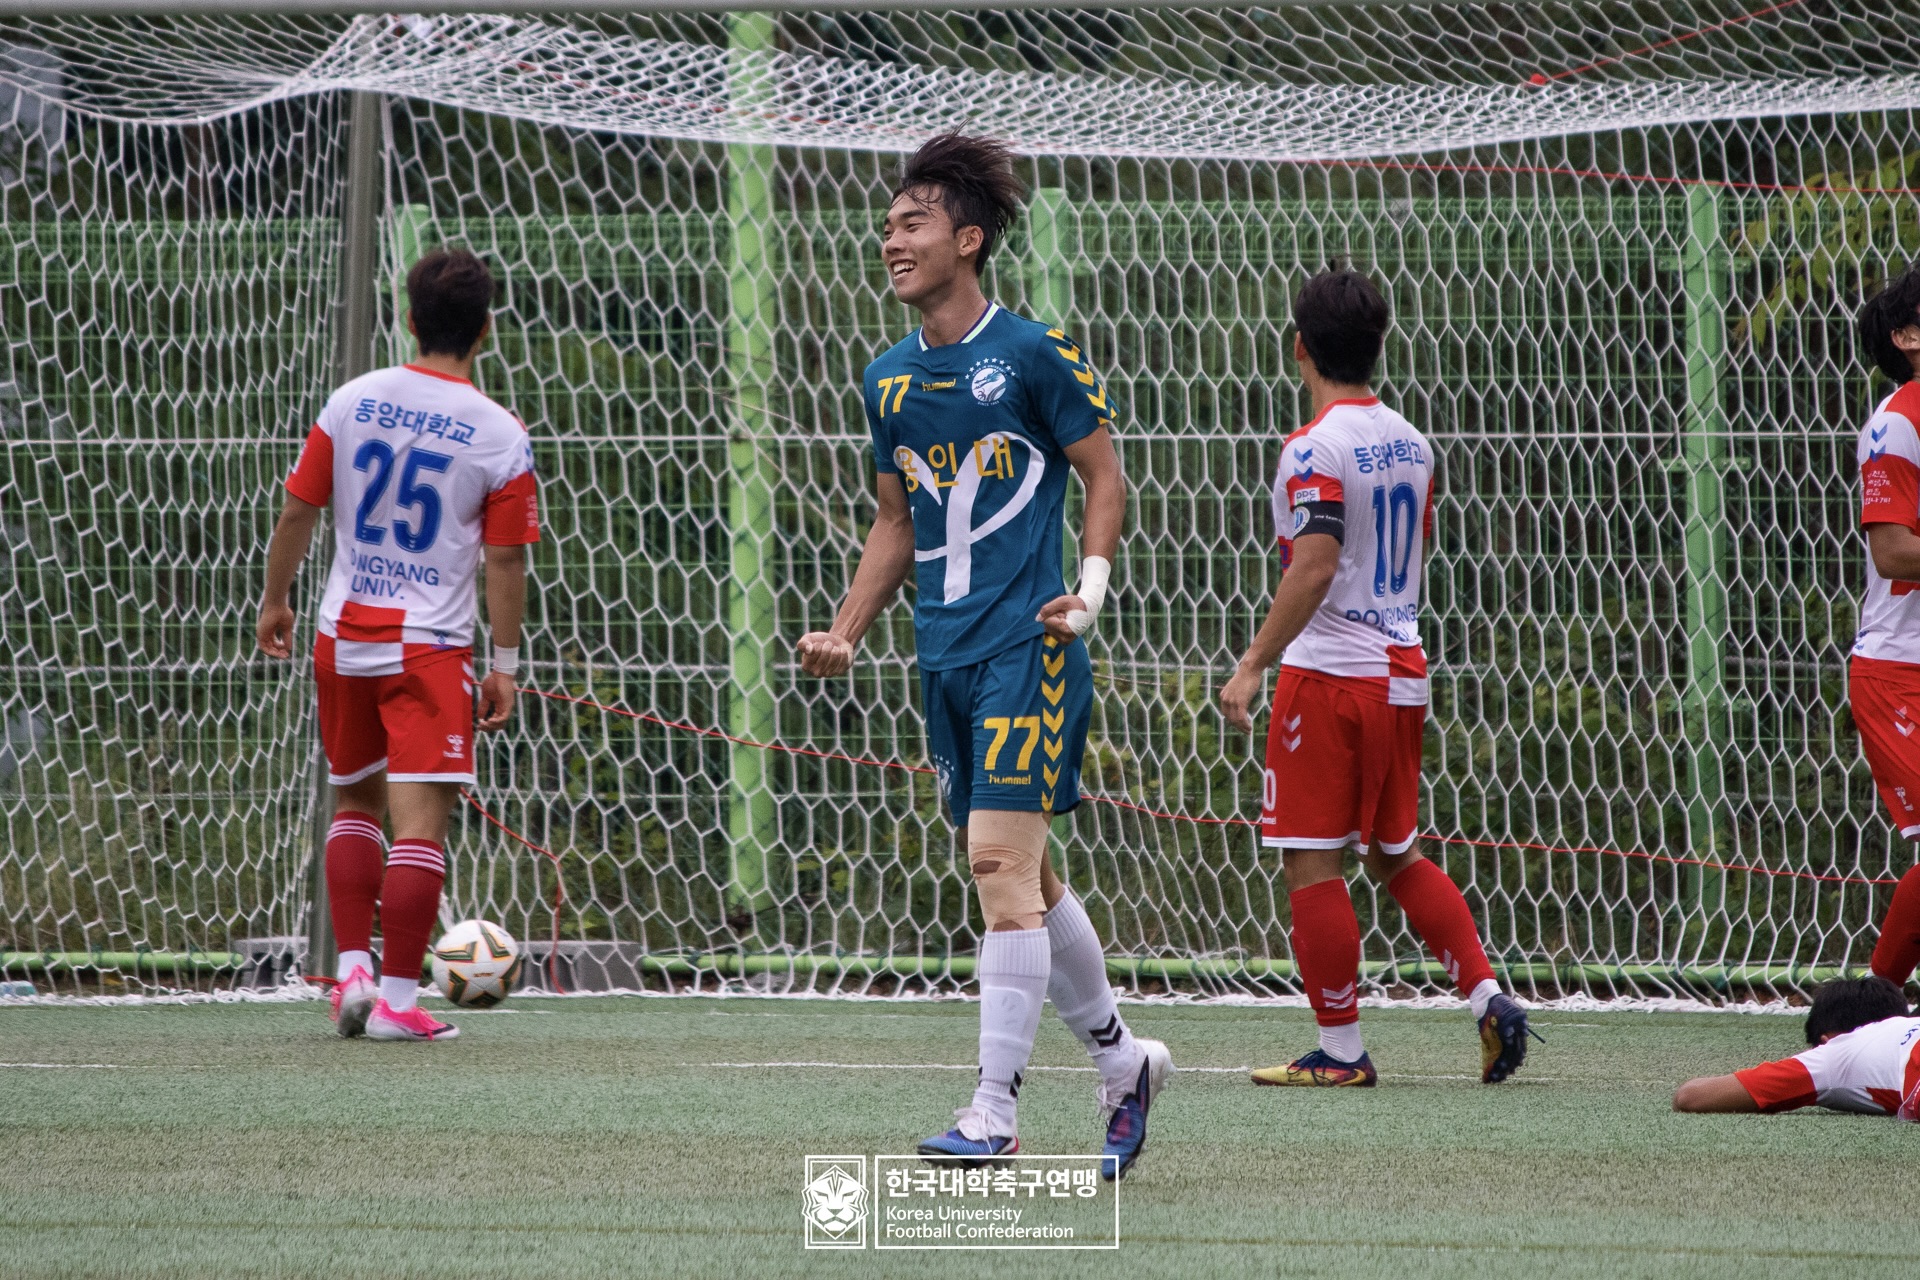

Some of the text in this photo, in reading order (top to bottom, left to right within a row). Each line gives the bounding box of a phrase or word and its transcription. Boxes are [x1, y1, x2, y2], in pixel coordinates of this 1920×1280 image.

[877, 374, 913, 419] 77
[921, 378, 957, 392] hummel
[354, 398, 477, 446] 동양대학교
[1353, 438, 1425, 474] 동양대학교
[352, 438, 455, 554] 25
[1372, 481, 1419, 598] 10
[351, 574, 405, 600] UNIV.
[983, 715, 1041, 771] 77
[989, 774, 1032, 785] hummel
